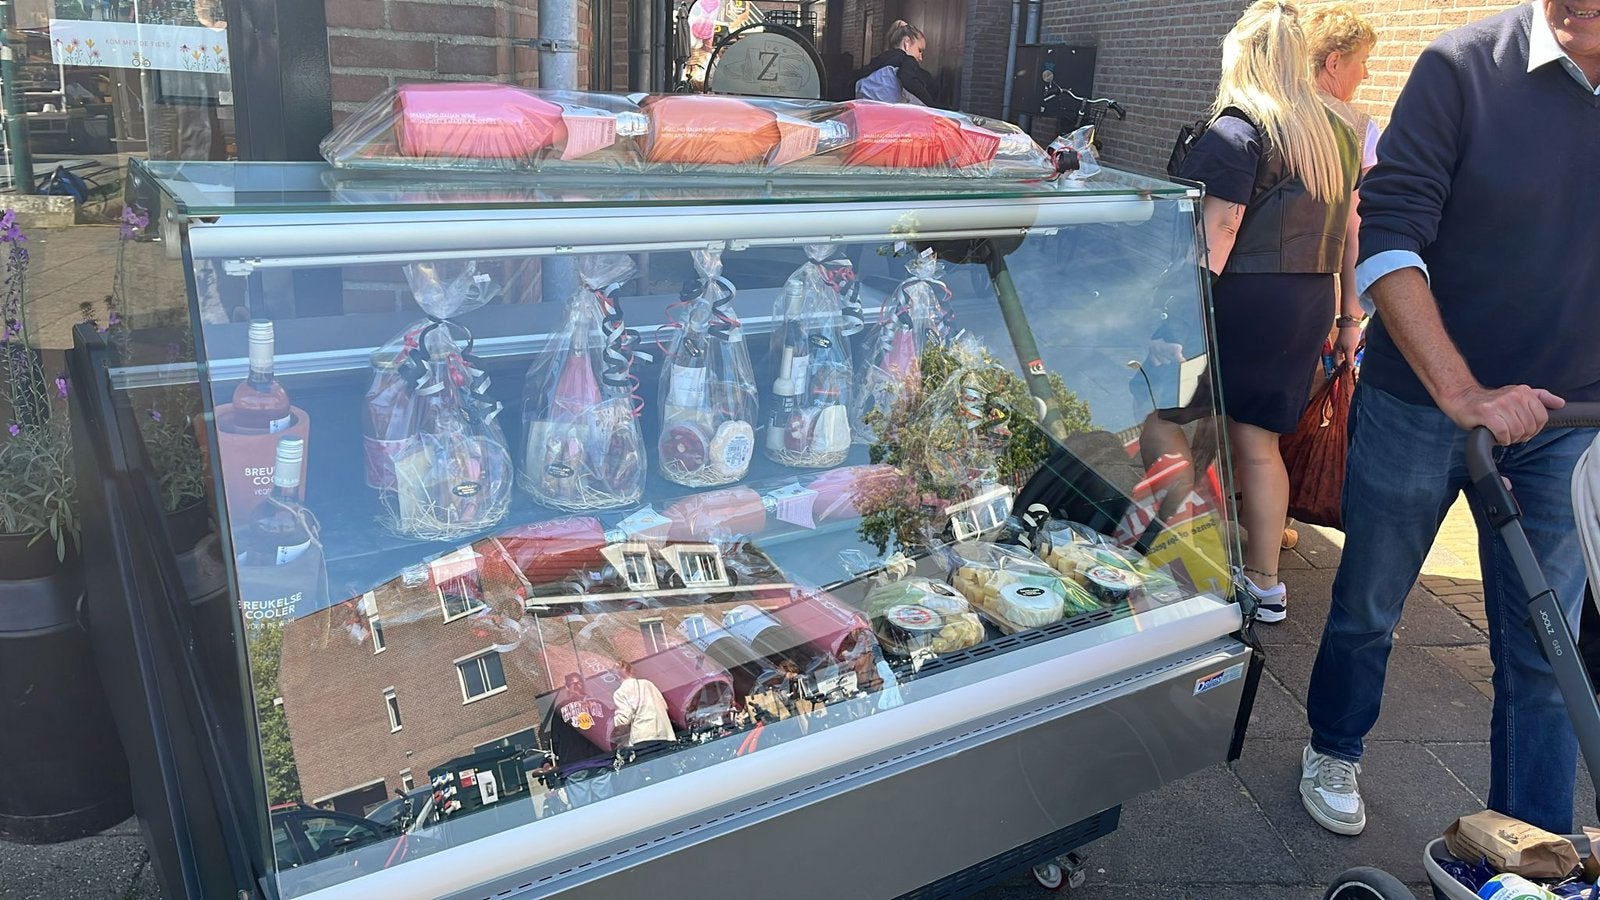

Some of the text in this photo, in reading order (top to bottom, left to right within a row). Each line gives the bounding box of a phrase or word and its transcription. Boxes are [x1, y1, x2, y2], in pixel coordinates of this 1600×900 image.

[757, 51, 779, 81] Z
[244, 467, 276, 477] BREU
[245, 604, 295, 619] COOLER
[1539, 609, 1563, 656] JOOLZ GEO
